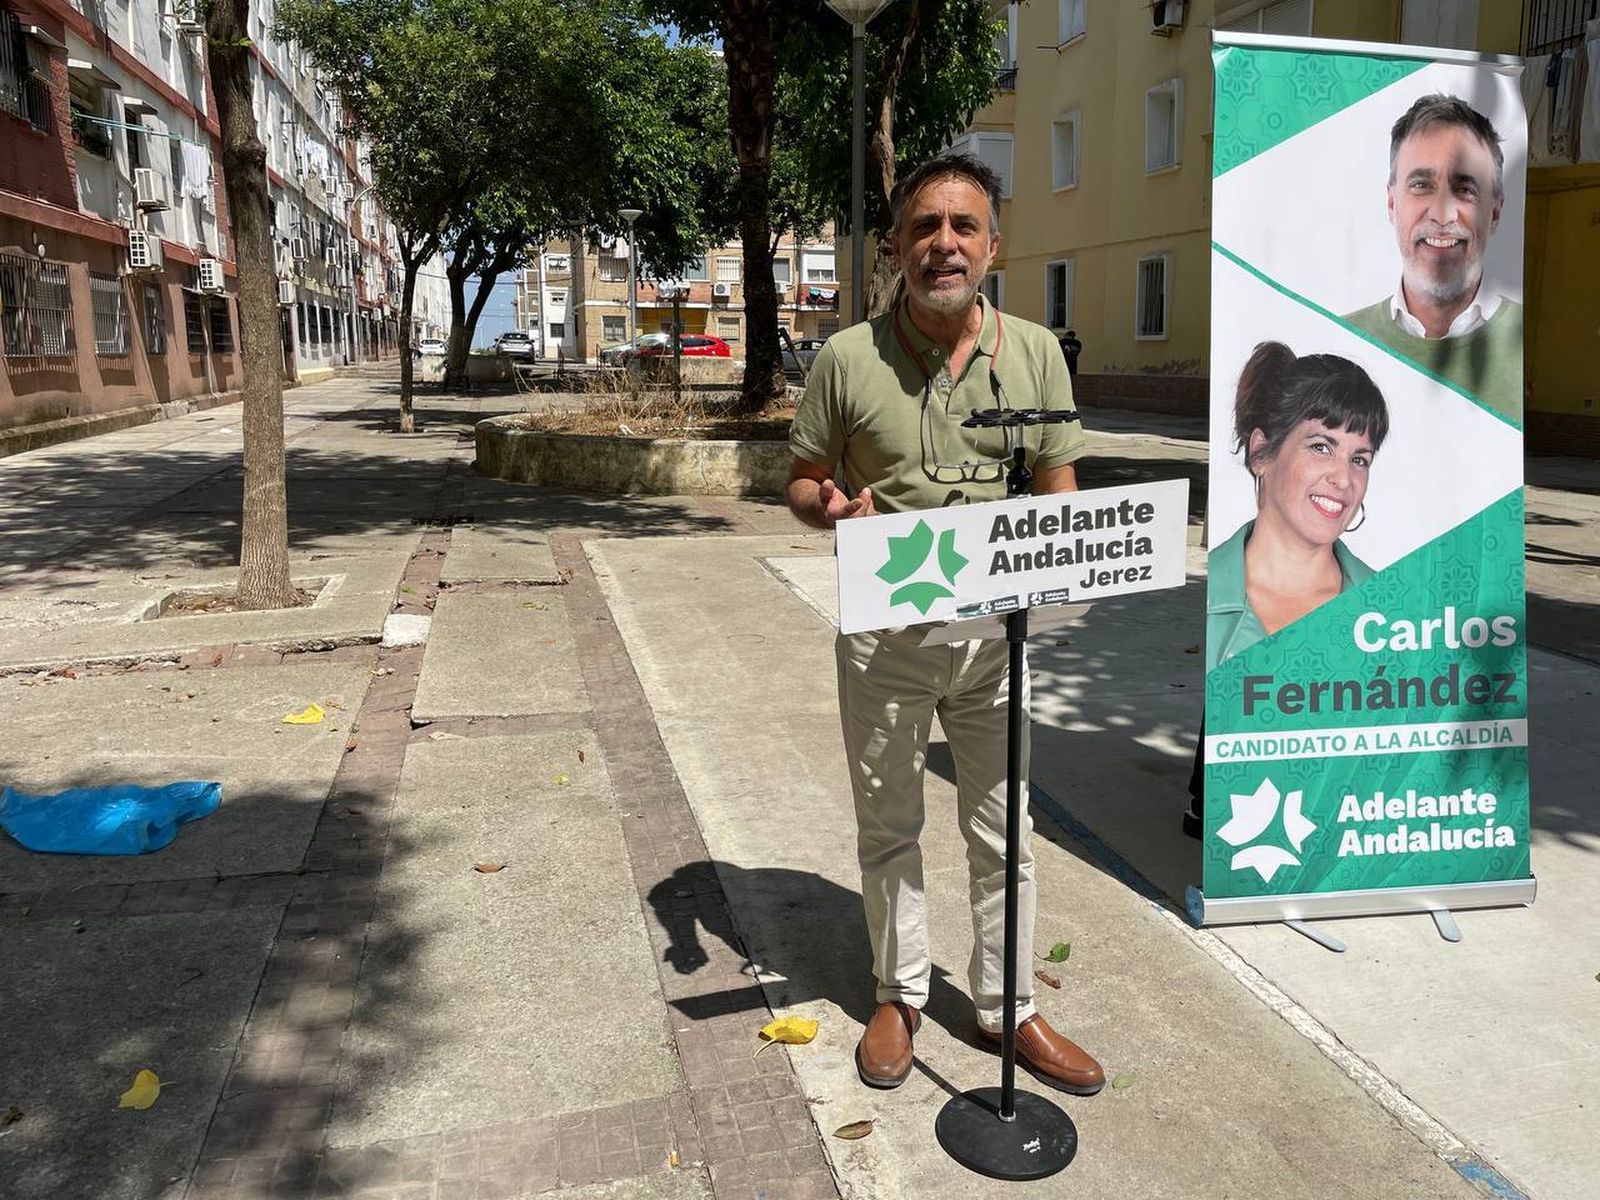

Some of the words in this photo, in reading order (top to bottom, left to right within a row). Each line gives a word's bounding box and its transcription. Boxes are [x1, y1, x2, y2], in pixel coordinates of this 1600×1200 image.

[988, 498, 1155, 543] Adelante
[988, 531, 1153, 576] Andalucía
[1079, 565, 1152, 589] Jerez
[1353, 606, 1518, 653] Carlos
[1243, 665, 1518, 716] Fernández
[1216, 735, 1347, 759] CANDIDATO
[1353, 734, 1369, 751] A
[1375, 732, 1402, 749] LA
[1408, 722, 1514, 748] ALCALDÍA
[1337, 788, 1497, 823] Adelante
[1337, 819, 1516, 857] Andalucía
